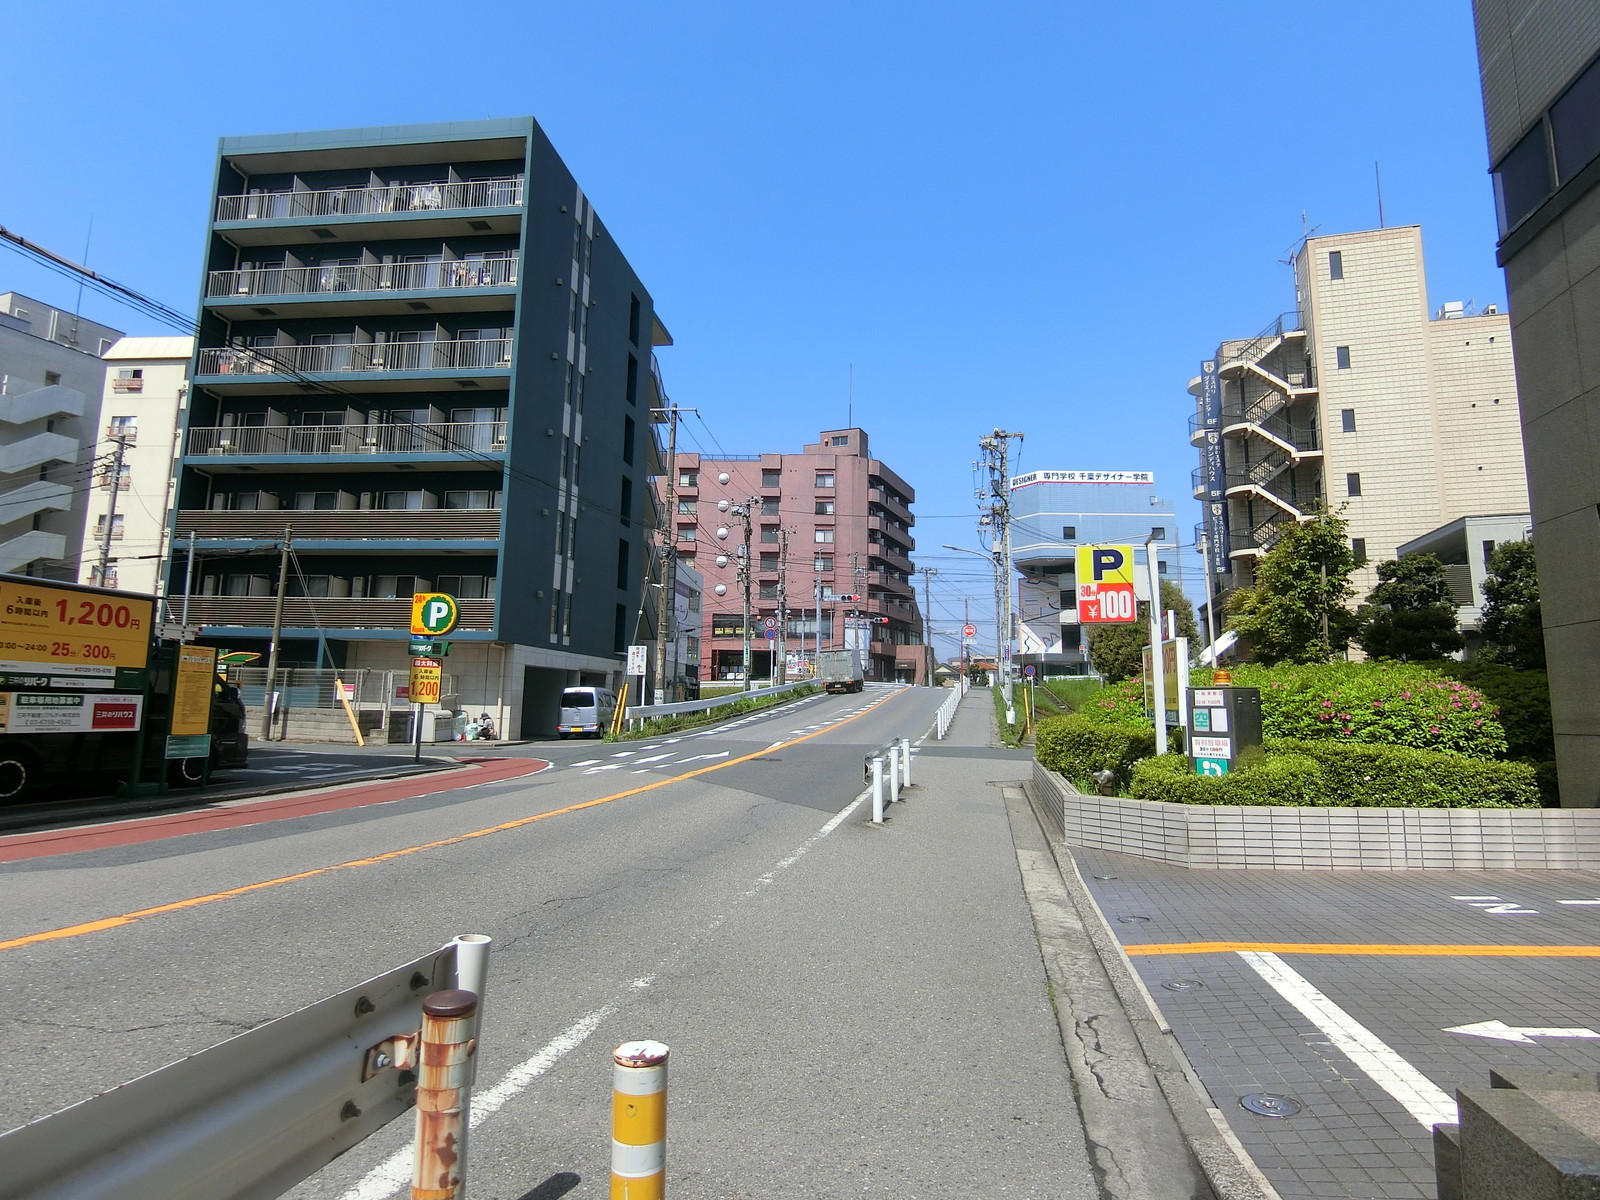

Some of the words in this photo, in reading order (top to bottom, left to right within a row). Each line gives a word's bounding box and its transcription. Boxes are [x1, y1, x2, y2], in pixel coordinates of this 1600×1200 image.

[1012, 473, 1037, 486] DESIGNER
[1043, 472, 1076, 481] 専門学校
[1079, 472, 1149, 482] 千葉デザイナー学院
[1093, 550, 1124, 580] P
[6, 605, 48, 618] 6時間以内
[56, 599, 140, 630] 1,200円
[429, 601, 449, 627] P
[411, 681, 438, 696] 1,200
[1195, 712, 1209, 727] 空
